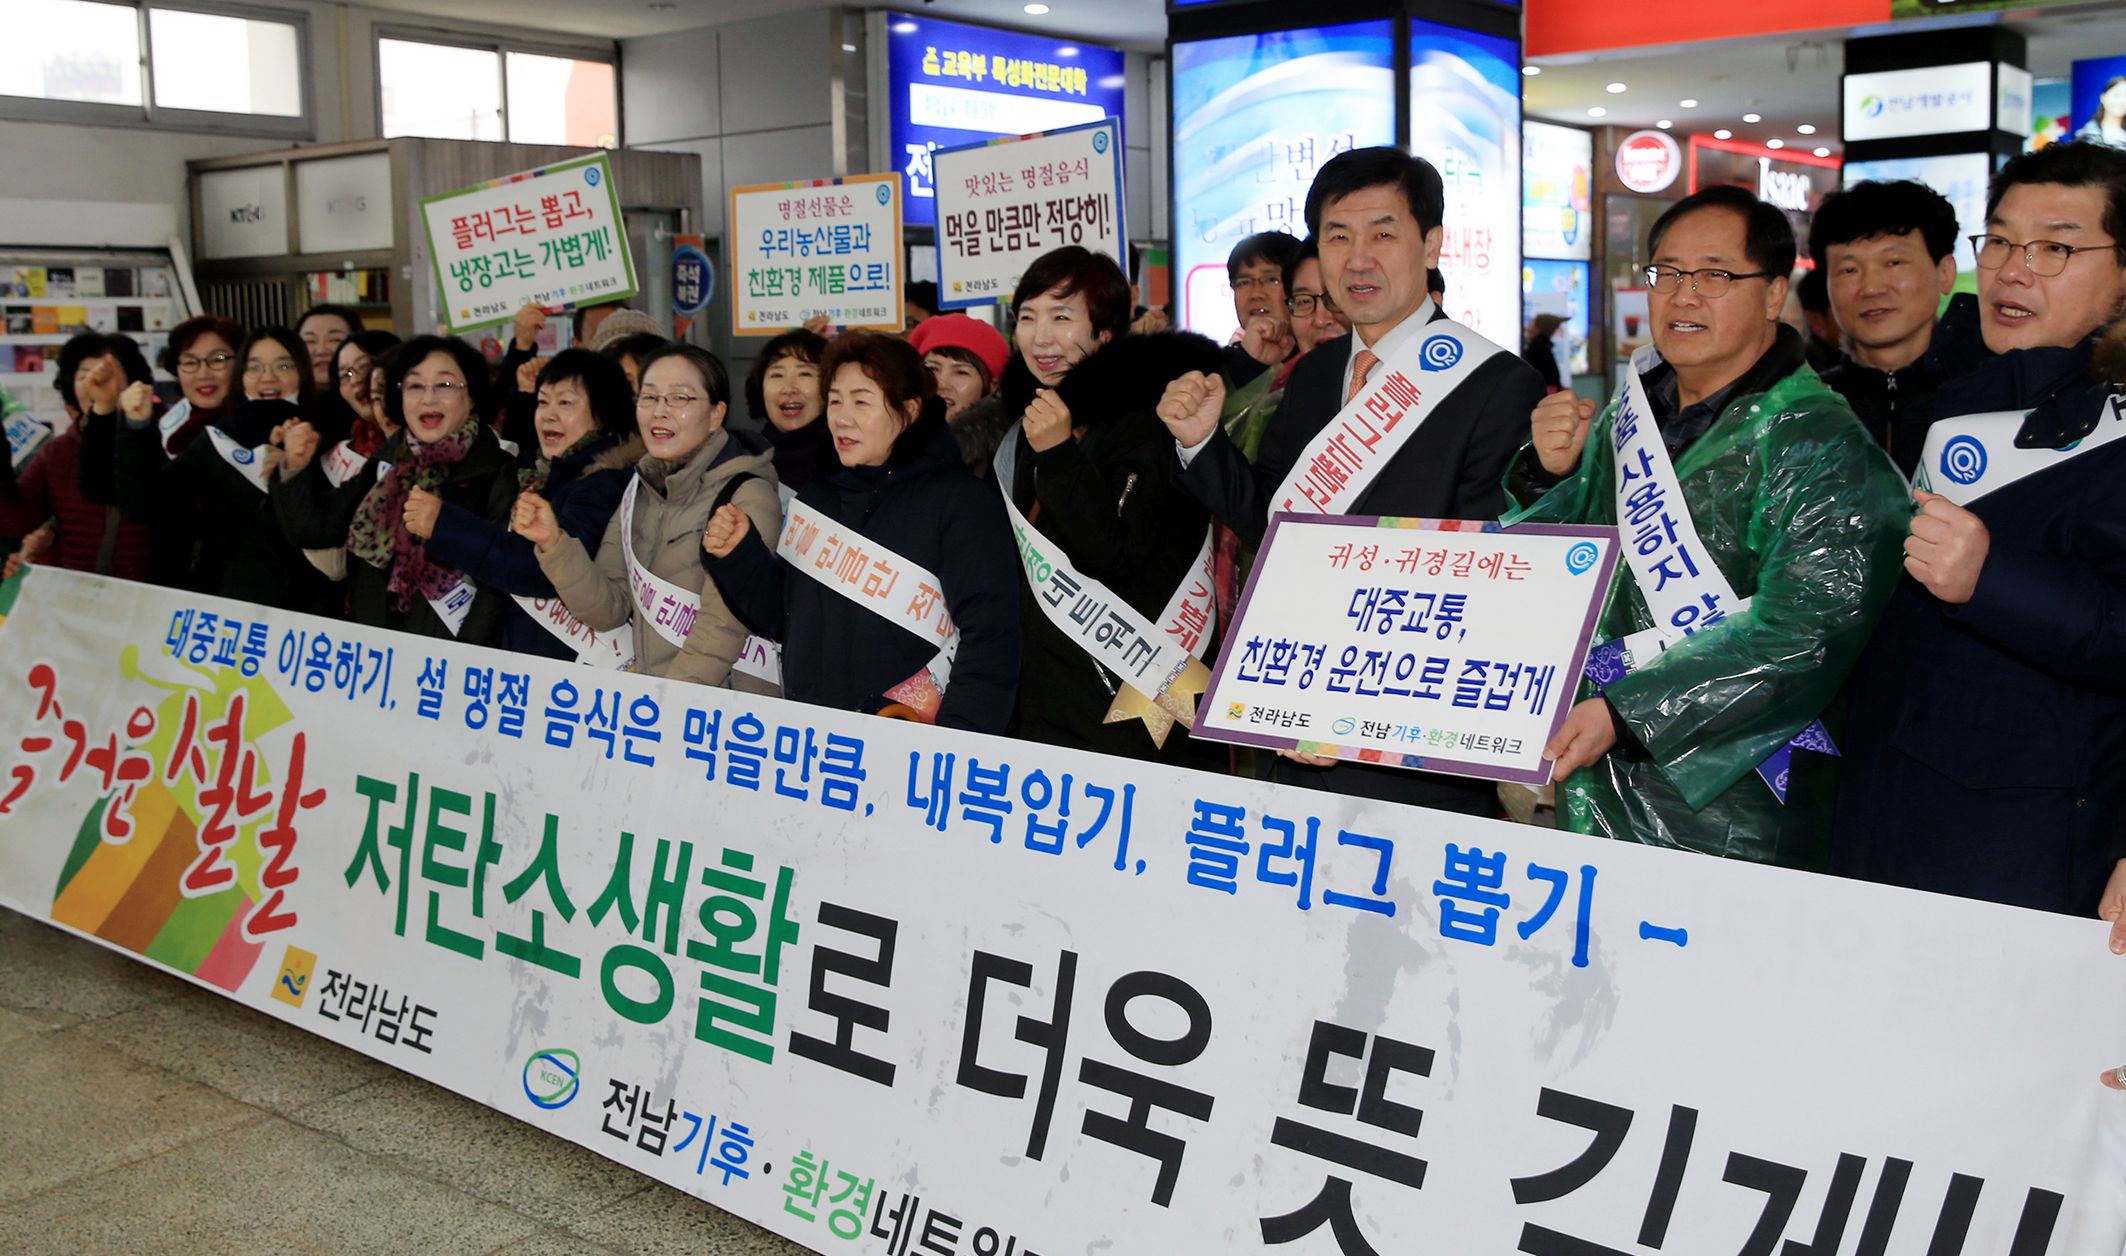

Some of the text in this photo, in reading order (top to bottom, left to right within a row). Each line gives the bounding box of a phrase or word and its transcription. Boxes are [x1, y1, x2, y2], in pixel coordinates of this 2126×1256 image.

[942, 50, 987, 82] 교육부
[965, 157, 1090, 199] 맛있는 명절음식
[1758, 156, 1811, 211] Isaac
[451, 190, 594, 250] 플러그는 뽑고,
[778, 195, 854, 221] 명절선물은
[946, 193, 1111, 257] 먹을 만큼만 적당히!
[450, 225, 613, 292] 냉장고는 가볍게!
[759, 222, 872, 259] 우리농산물과
[748, 262, 891, 298] 친환경 제품으로!
[965, 278, 999, 293] 전라남도
[473, 301, 508, 318] 전라남도
[758, 310, 789, 322] 전라남도
[1619, 448, 1700, 592] 사용하지
[815, 533, 900, 600] 만큼만
[1347, 586, 1468, 645] 대중교통,
[1237, 634, 1556, 716] 친환경 운전으로 즐겁게
[1248, 705, 1312, 730] 전라남도
[165, 607, 270, 678] 대중교통
[278, 626, 396, 711] 이용하기,
[416, 656, 448, 721] 설
[463, 665, 531, 740] 명절
[544, 678, 664, 768] 음식은
[683, 706, 876, 818] 먹을만큼,
[906, 750, 1147, 877] 내복입기,
[1186, 798, 1397, 919] 플러그
[1432, 842, 1599, 969] 뽑기
[166, 694, 327, 936] 설날
[319, 968, 440, 1054] 전라남도
[344, 771, 898, 1088] 저탄소생활로
[955, 948, 1216, 1210] 더욱
[1259, 1018, 1437, 1256] 뜻
[541, 1069, 565, 1088] KCEN
